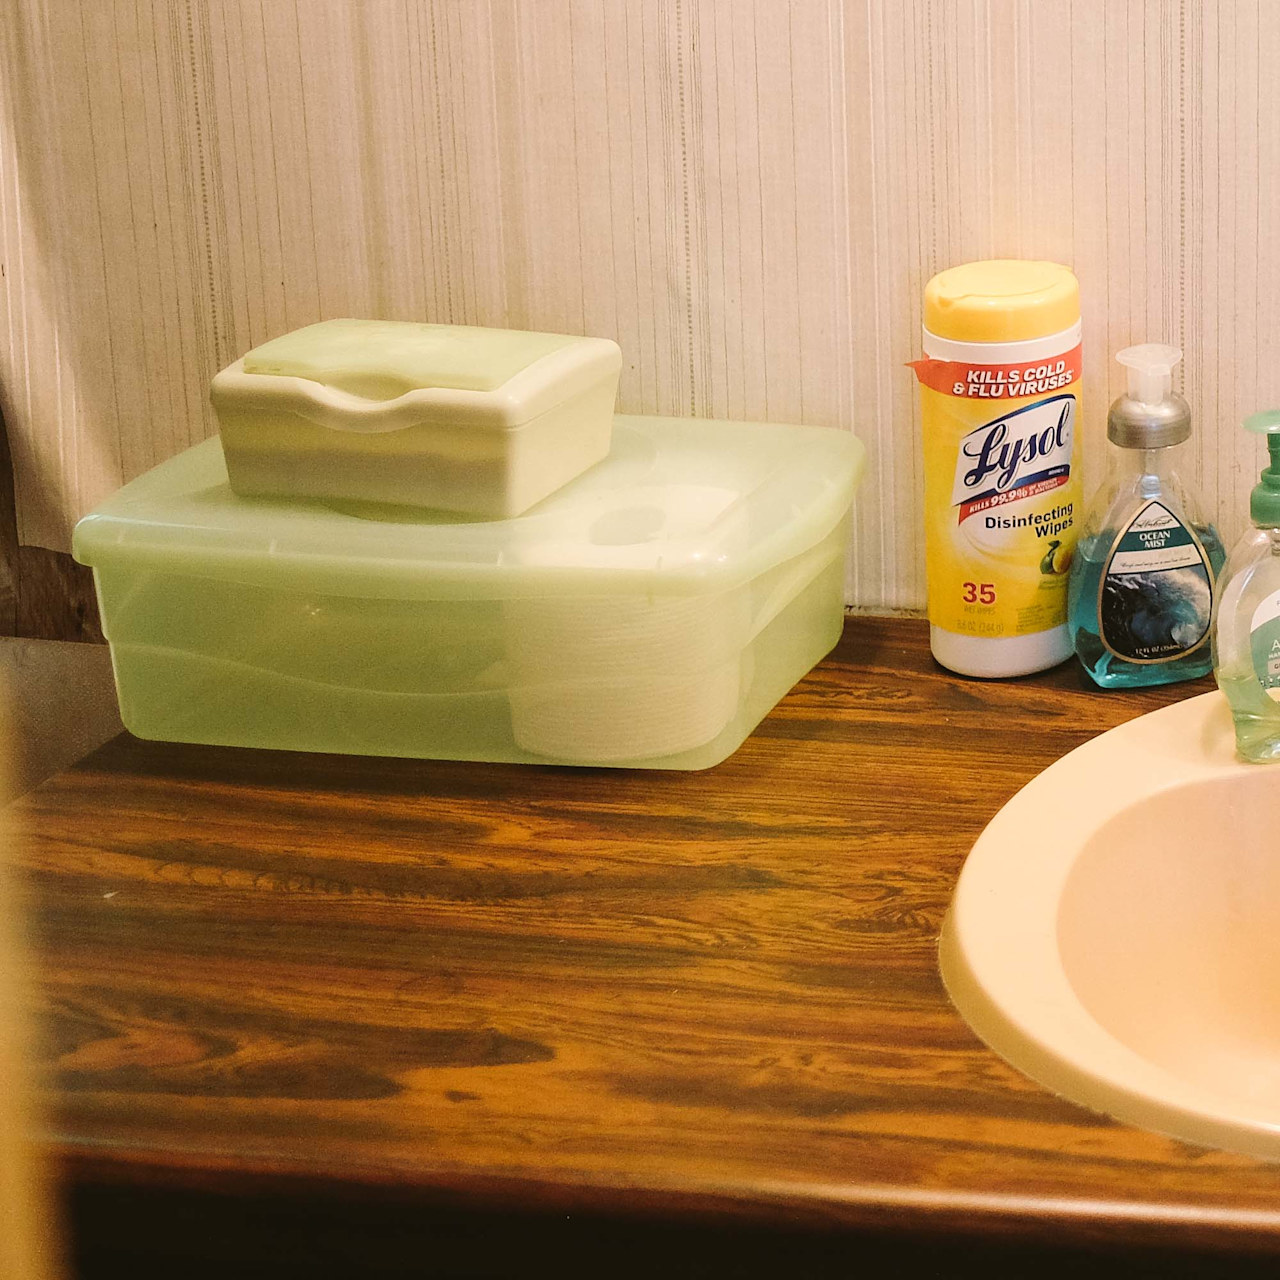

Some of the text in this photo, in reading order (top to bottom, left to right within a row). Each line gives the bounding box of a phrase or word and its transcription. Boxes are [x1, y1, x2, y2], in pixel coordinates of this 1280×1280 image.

[967, 360, 1066, 383] KILLS COLD
[952, 371, 1073, 397] & FLU VIRUSES
[963, 401, 1070, 489] Lysol
[969, 488, 1028, 513] KILLS 99.9%
[985, 503, 1073, 529] Disinfecting
[1035, 517, 1074, 538] Wipes
[1140, 530, 1171, 541] OCEAN
[1144, 540, 1166, 548] MIST
[962, 582, 996, 605] 35
